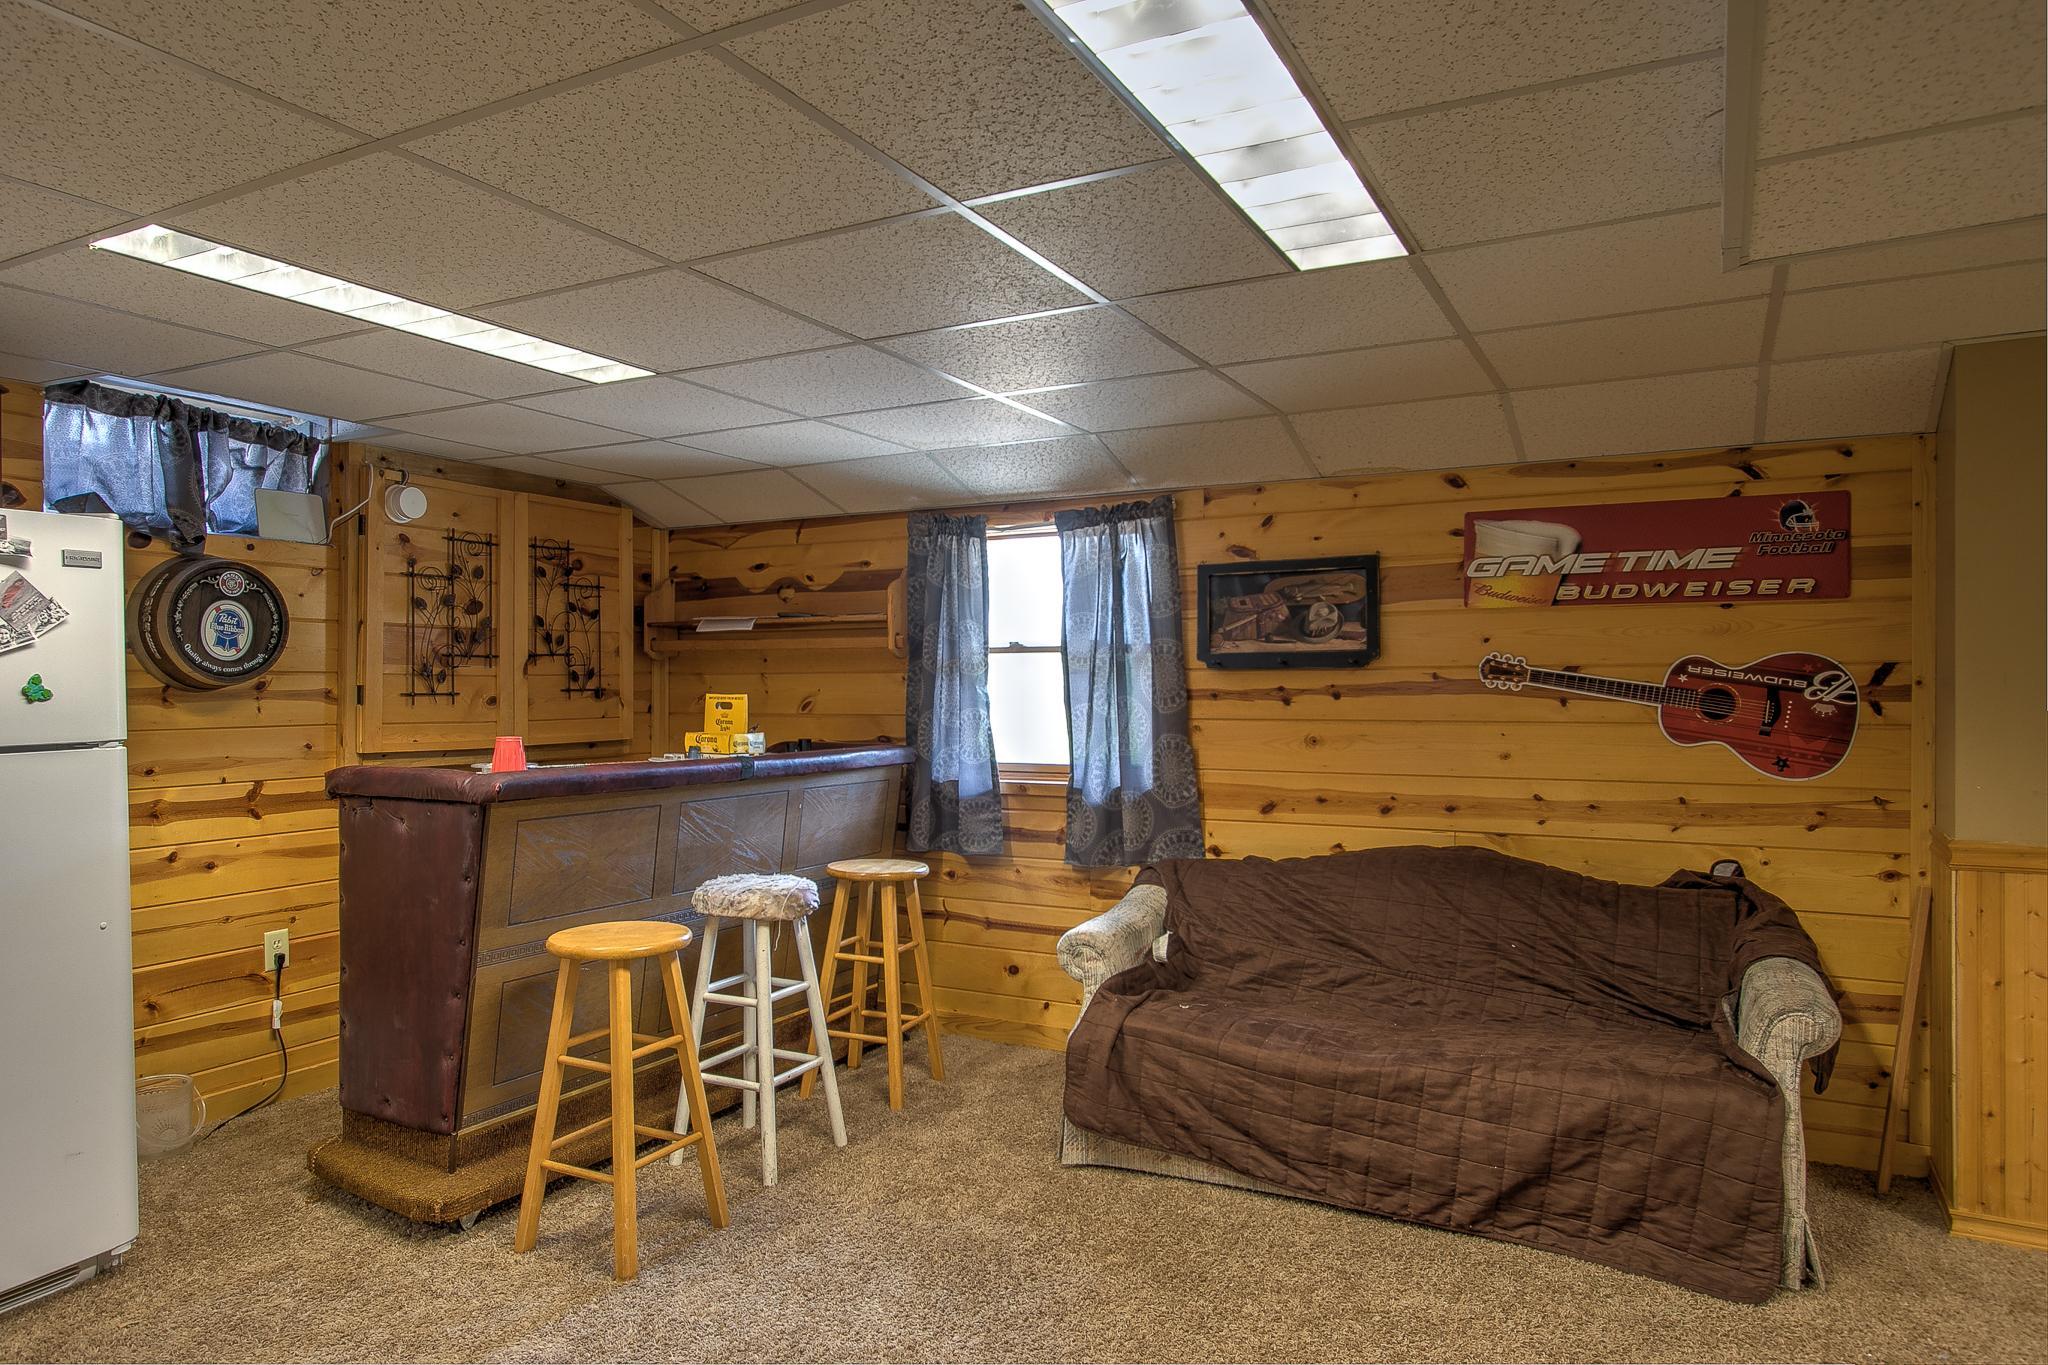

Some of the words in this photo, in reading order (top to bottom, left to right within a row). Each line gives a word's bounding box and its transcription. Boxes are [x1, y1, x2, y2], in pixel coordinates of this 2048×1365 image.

[1750, 529, 1848, 544] Minnesota
[1757, 541, 1836, 556] Football
[1466, 552, 1612, 578] GAME
[1617, 546, 1744, 573] TIME
[1473, 582, 1548, 604] Budweiser
[1556, 578, 1816, 600] BUDWEISER
[211, 622, 225, 631] Blue
[219, 613, 239, 625] Pabst
[184, 643, 203, 663] Quality
[201, 661, 222, 673] always
[222, 665, 243, 673] comes
[1688, 665, 1809, 689] BUDWEISER
[695, 734, 718, 744] Corona
